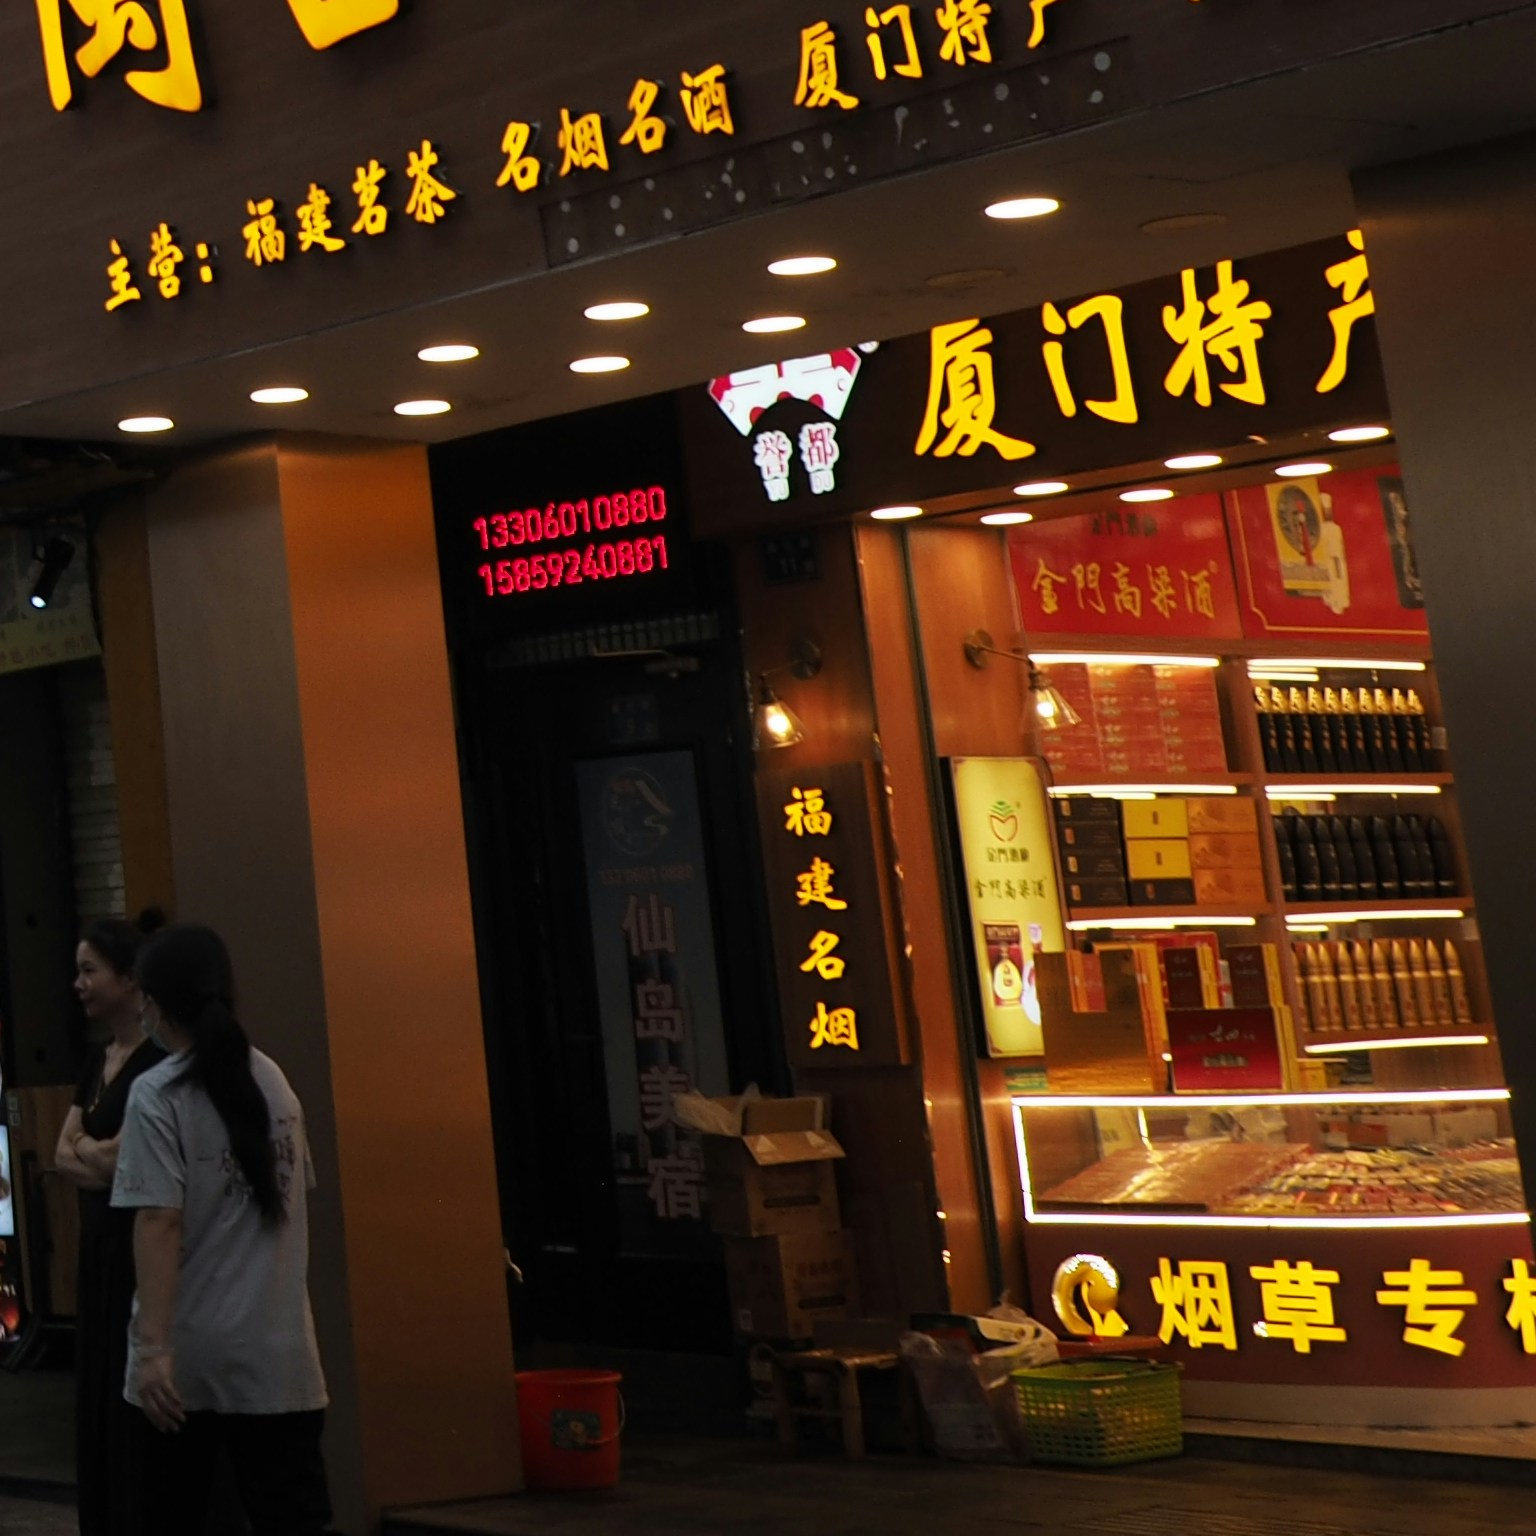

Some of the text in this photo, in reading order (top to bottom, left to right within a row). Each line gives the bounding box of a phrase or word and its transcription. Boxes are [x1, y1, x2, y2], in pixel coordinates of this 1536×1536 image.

[242, 139, 457, 267] 福建茗茶
[496, 64, 735, 193] 名烟名酒
[914, 228, 1376, 461] 厦门特产
[473, 485, 667, 550] 13306010880
[478, 534, 668, 596] 15859240881
[784, 786, 860, 1051] 福建名烟
[621, 891, 707, 1220] 仙岛美宿
